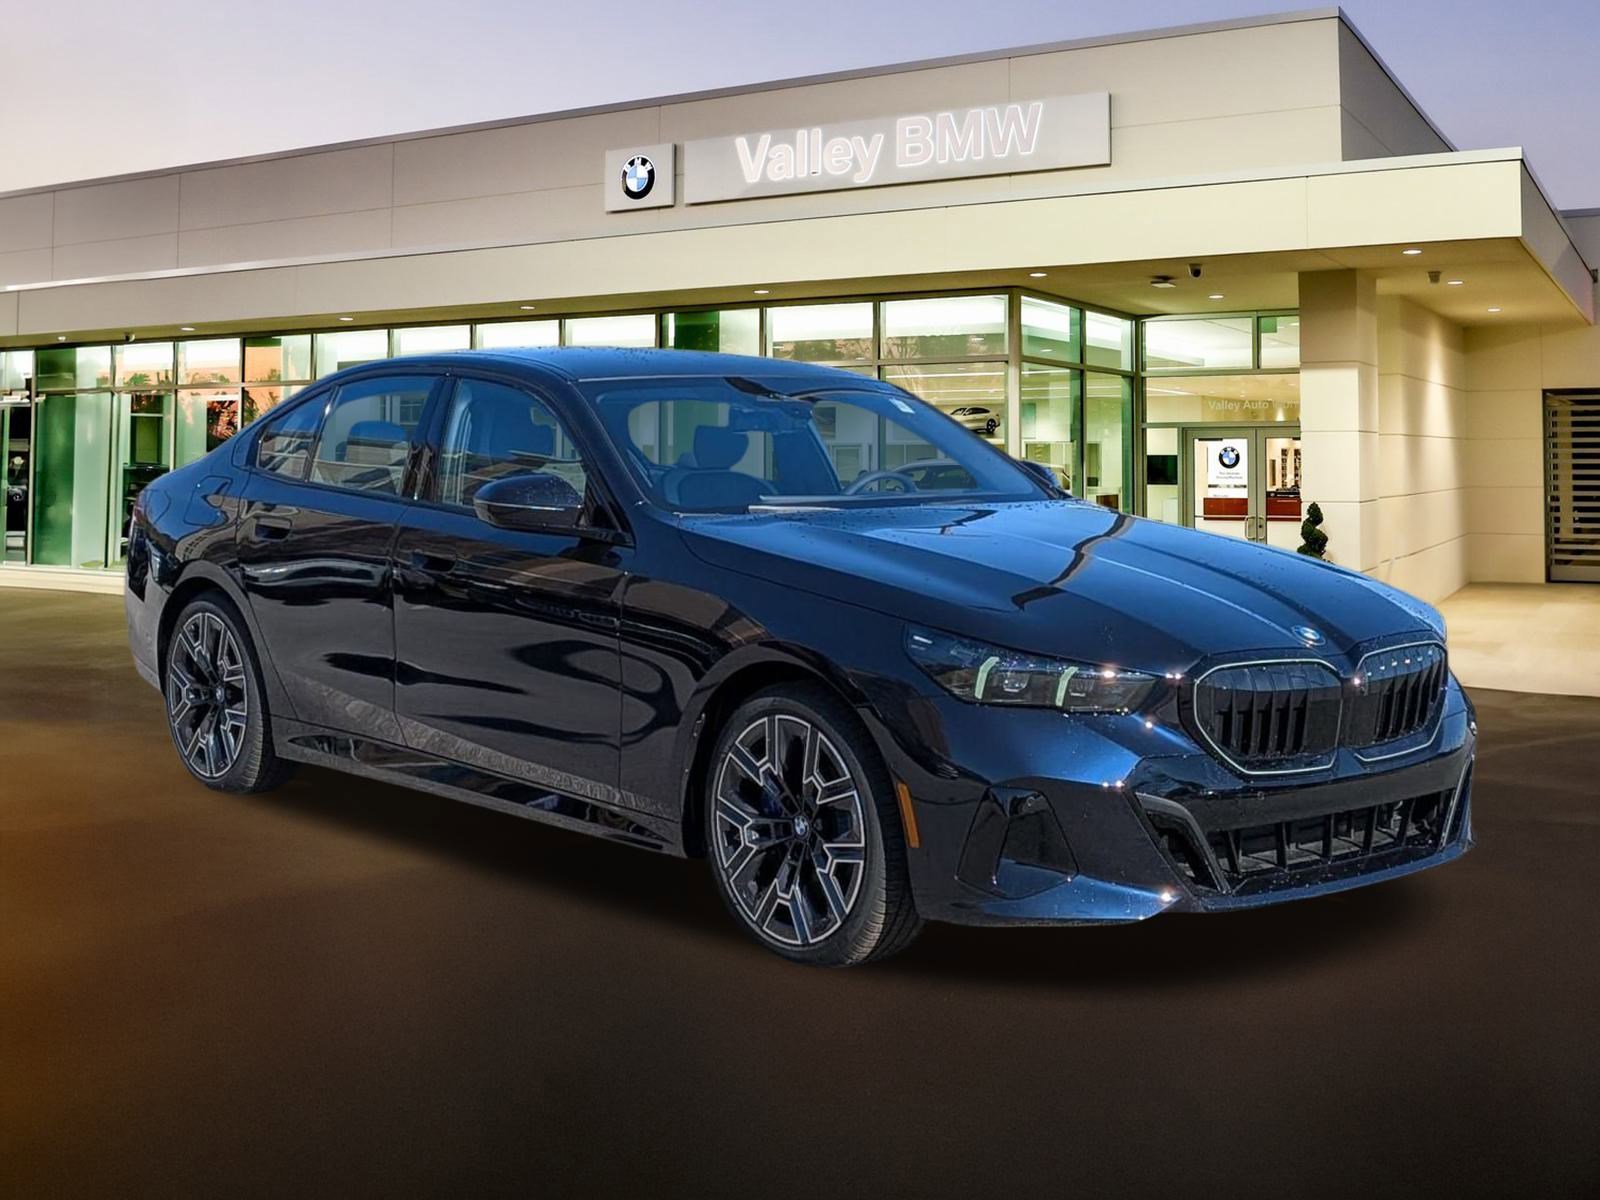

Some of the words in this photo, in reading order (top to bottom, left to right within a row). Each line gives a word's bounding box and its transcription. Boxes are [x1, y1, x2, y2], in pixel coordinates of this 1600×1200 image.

[736, 127, 884, 184] Valley
[896, 102, 1043, 167] BMW
[1208, 399, 1240, 412] Valley
[1243, 399, 1269, 409] Auto
